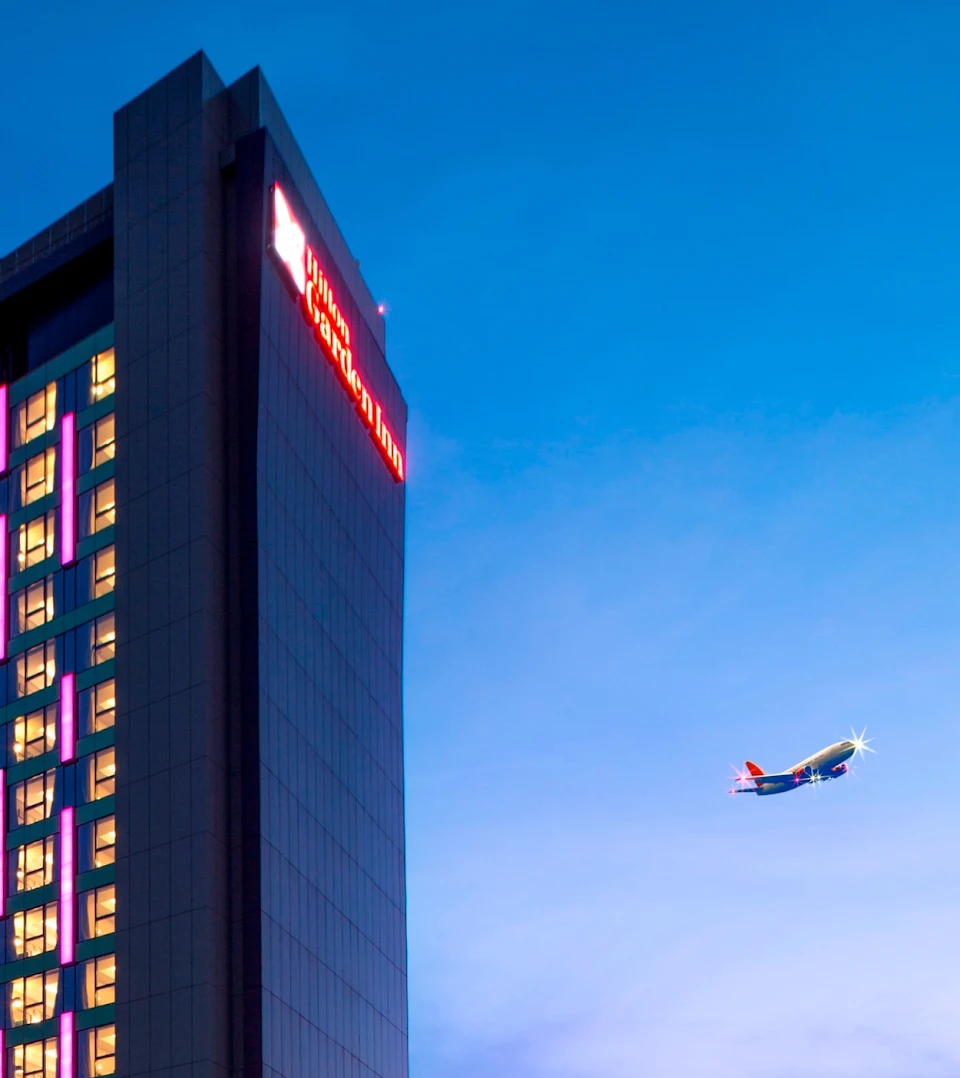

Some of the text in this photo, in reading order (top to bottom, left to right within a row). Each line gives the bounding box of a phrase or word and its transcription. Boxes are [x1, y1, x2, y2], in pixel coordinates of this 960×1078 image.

[305, 246, 350, 345] Hilton
[305, 279, 404, 478] Garden Inn
